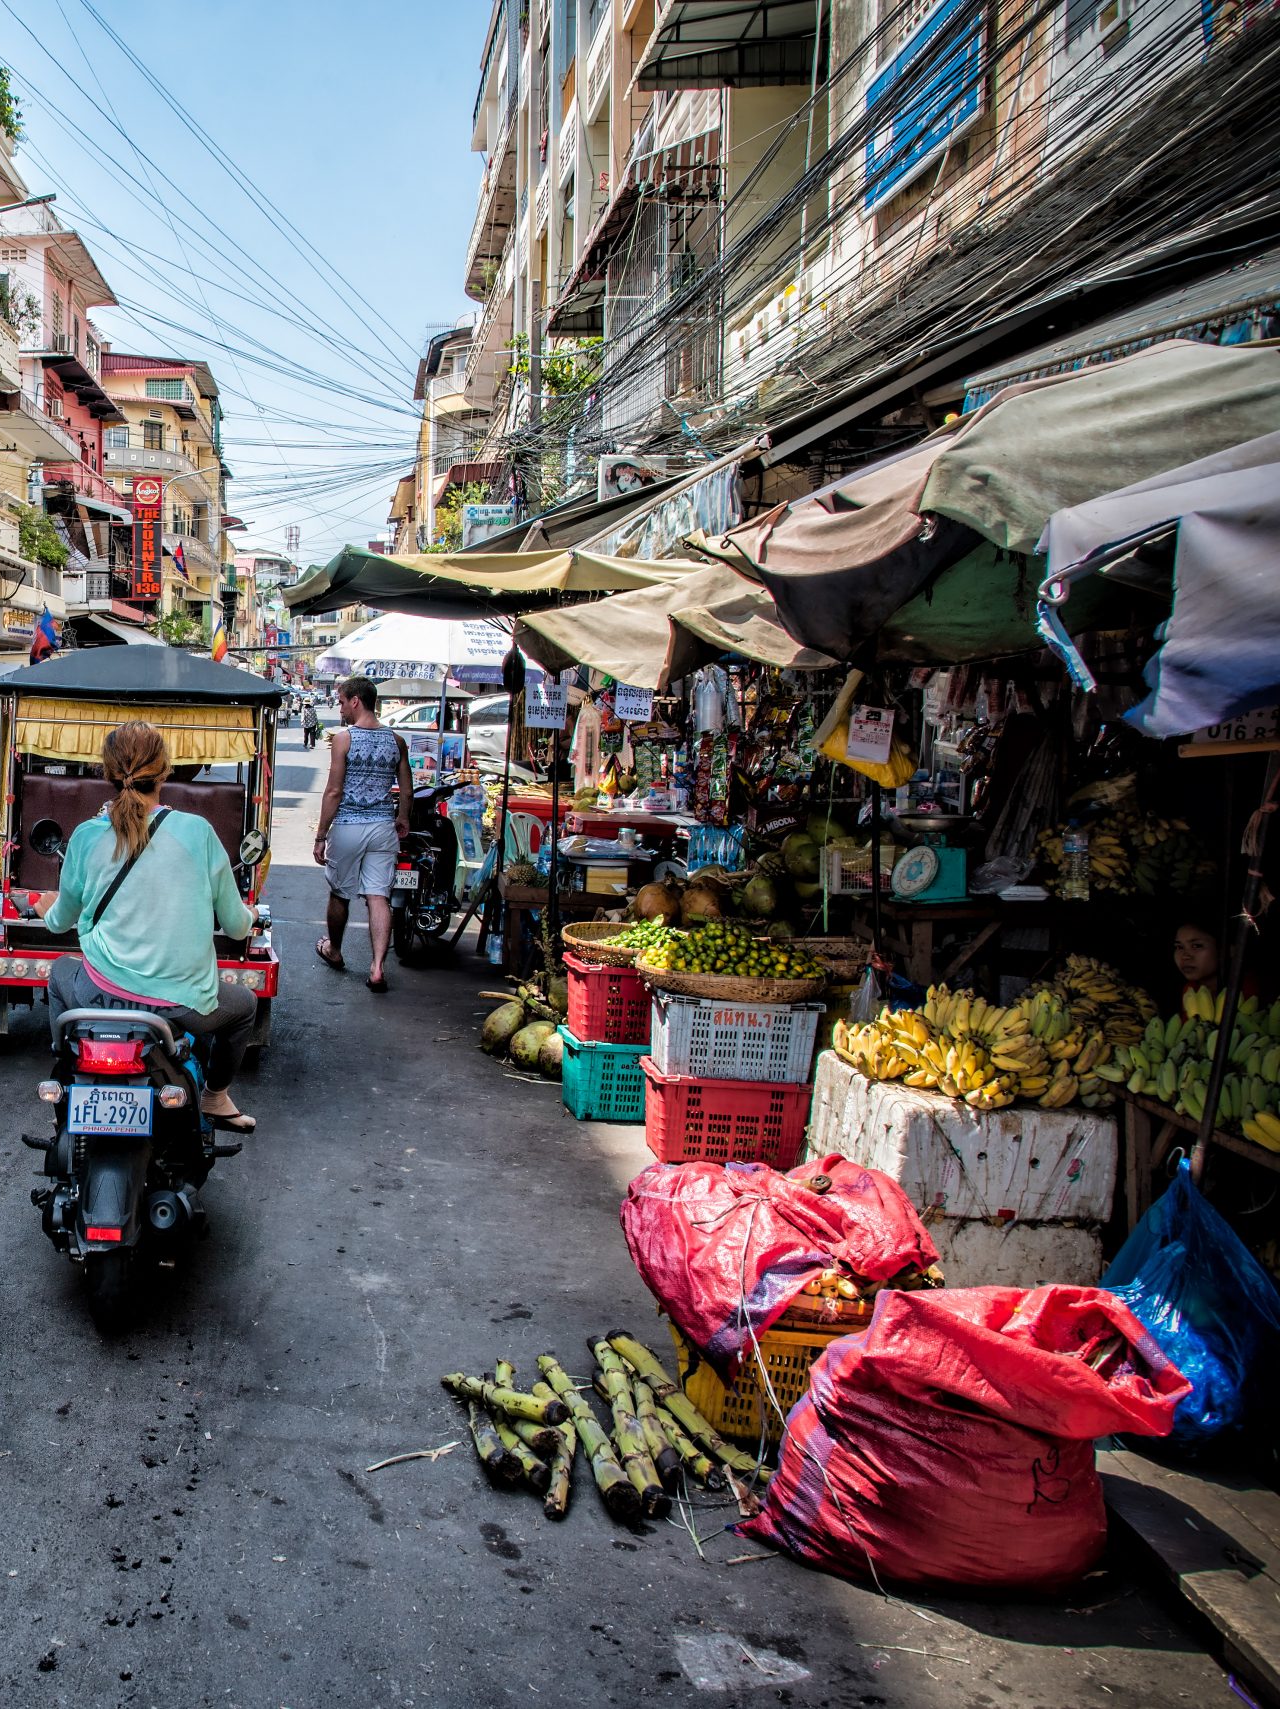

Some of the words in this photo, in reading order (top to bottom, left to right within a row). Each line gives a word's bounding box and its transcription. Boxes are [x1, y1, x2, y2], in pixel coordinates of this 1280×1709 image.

[137, 508, 160, 518] THE
[142, 519, 155, 583] CORNER
[136, 583, 160, 593] 136
[380, 661, 396, 670] 023
[89, 1088, 135, 1106] ភ្នំពេញ
